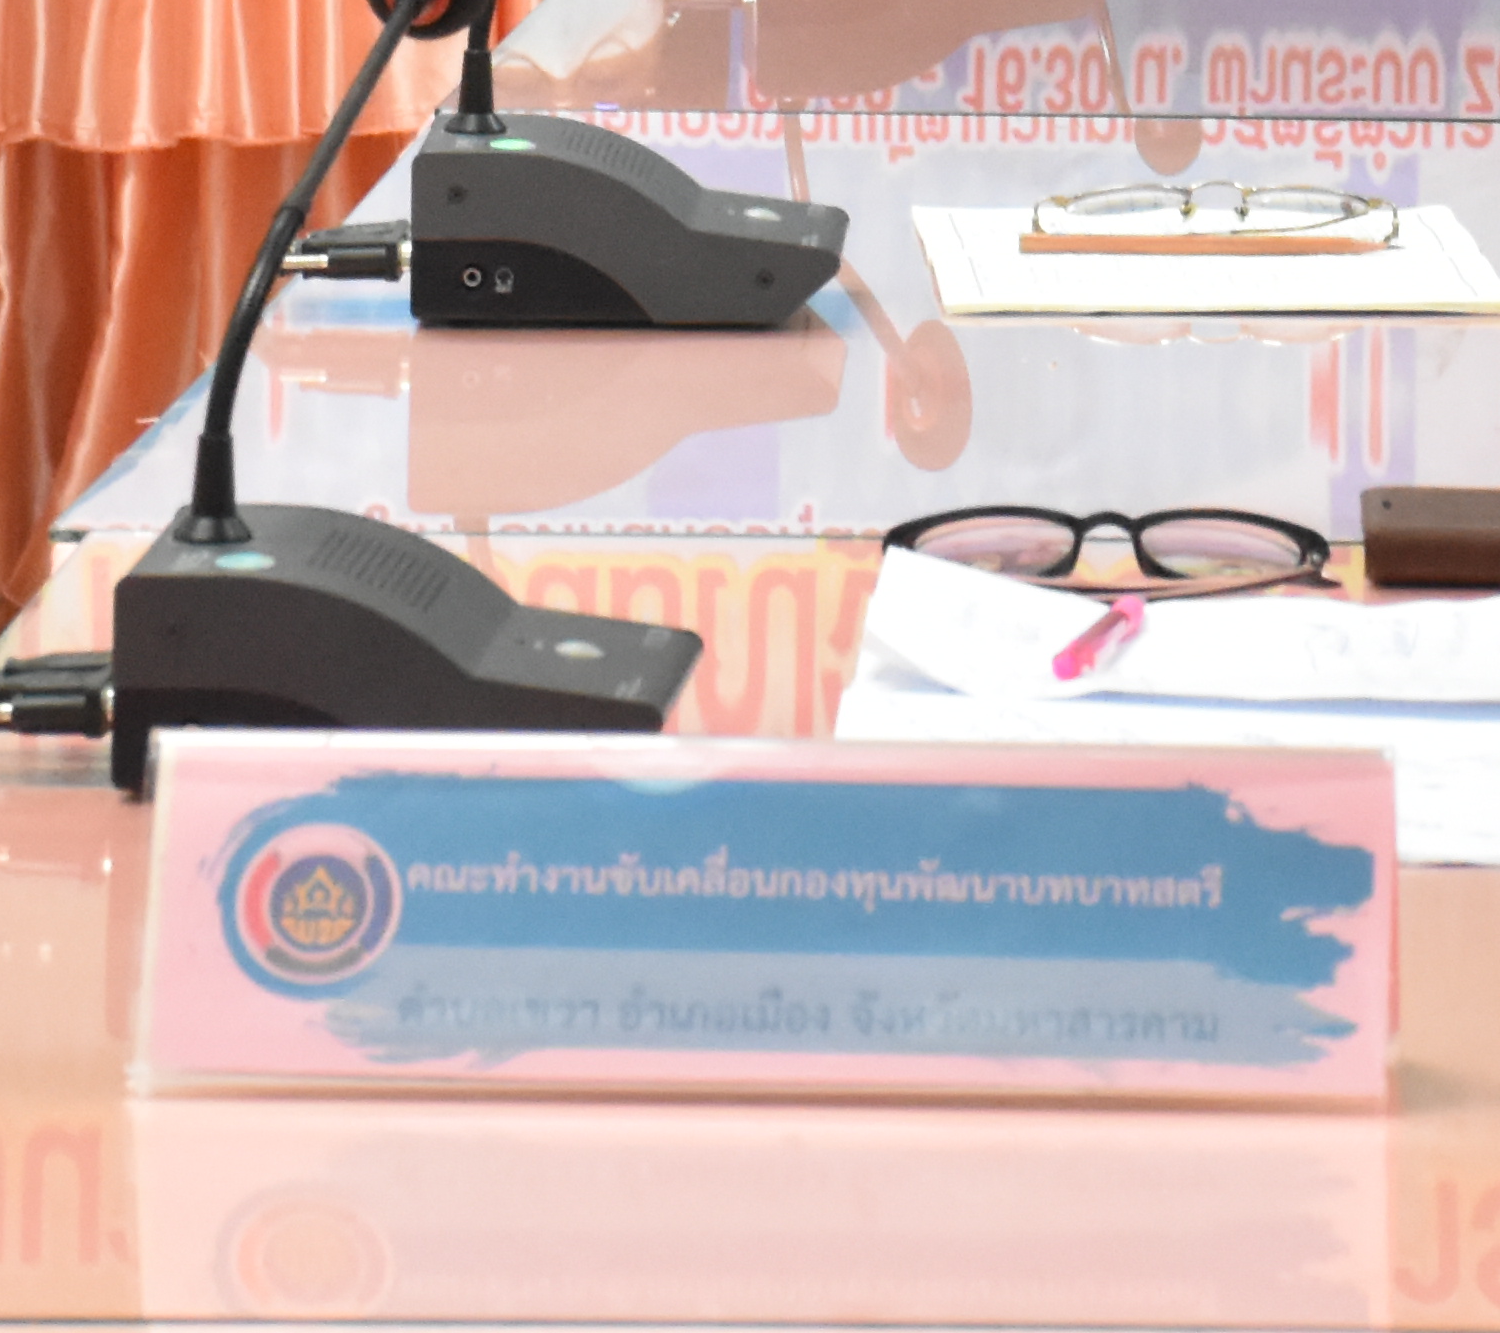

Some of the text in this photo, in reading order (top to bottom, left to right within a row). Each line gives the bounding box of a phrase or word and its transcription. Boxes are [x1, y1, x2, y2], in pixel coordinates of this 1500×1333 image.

[406, 844, 1223, 913] คณะทำงานขับเคลื่อนกองทุนพัฒนาบทบาทสตรี
